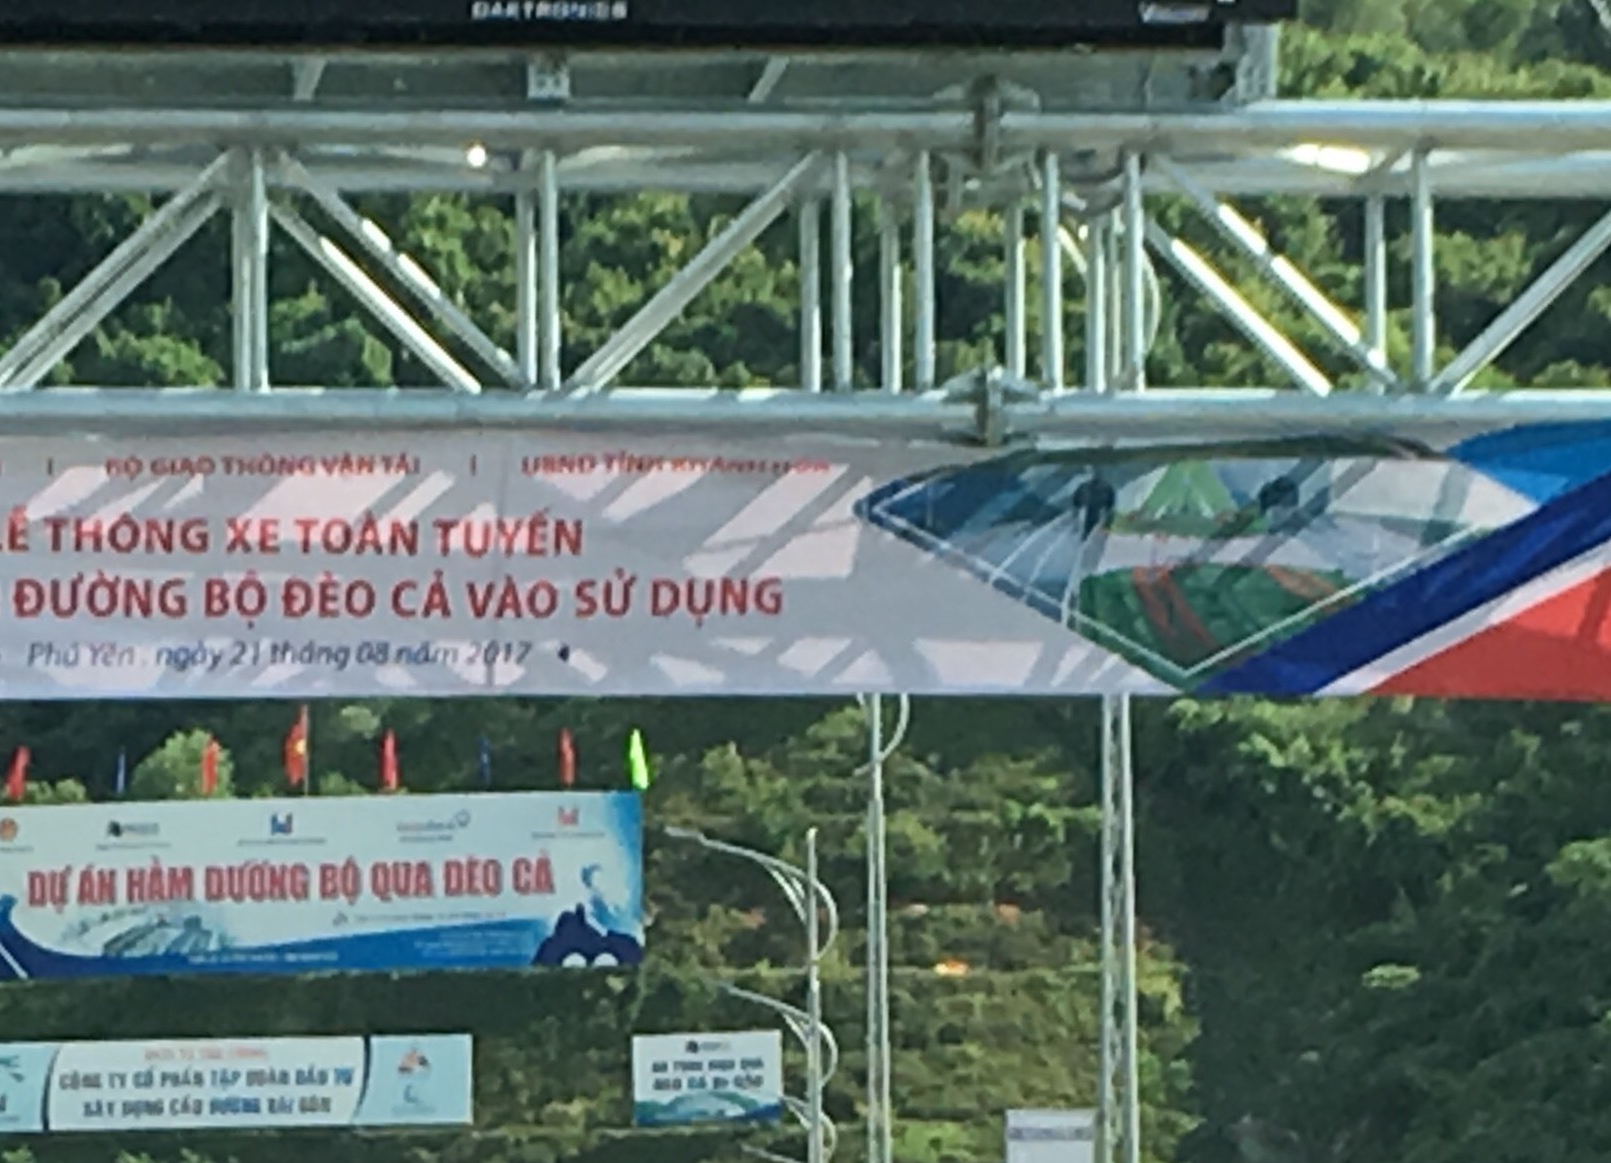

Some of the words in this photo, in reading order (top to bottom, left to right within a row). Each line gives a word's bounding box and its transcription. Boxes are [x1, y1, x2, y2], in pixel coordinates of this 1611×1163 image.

[42, 513, 209, 554] THÔNG
[226, 518, 281, 554] XE
[293, 511, 420, 556] TOÀN
[435, 508, 583, 558] TUYẾN
[13, 569, 188, 619] ĐƯỜNG
[204, 570, 268, 629] BỘ
[280, 569, 376, 619] ĐÈO
[390, 568, 452, 619] CẢ
[466, 572, 560, 619] VÀO
[574, 566, 636, 618] SỬ
[650, 577, 784, 629] DỤNG
[155, 640, 224, 672] ngày
[230, 640, 261, 668] 21
[269, 641, 350, 672] tháng
[355, 642, 389, 665] 08
[465, 640, 533, 665] 2017
[319, 856, 362, 905] BỘ
[370, 860, 434, 902] QUA
